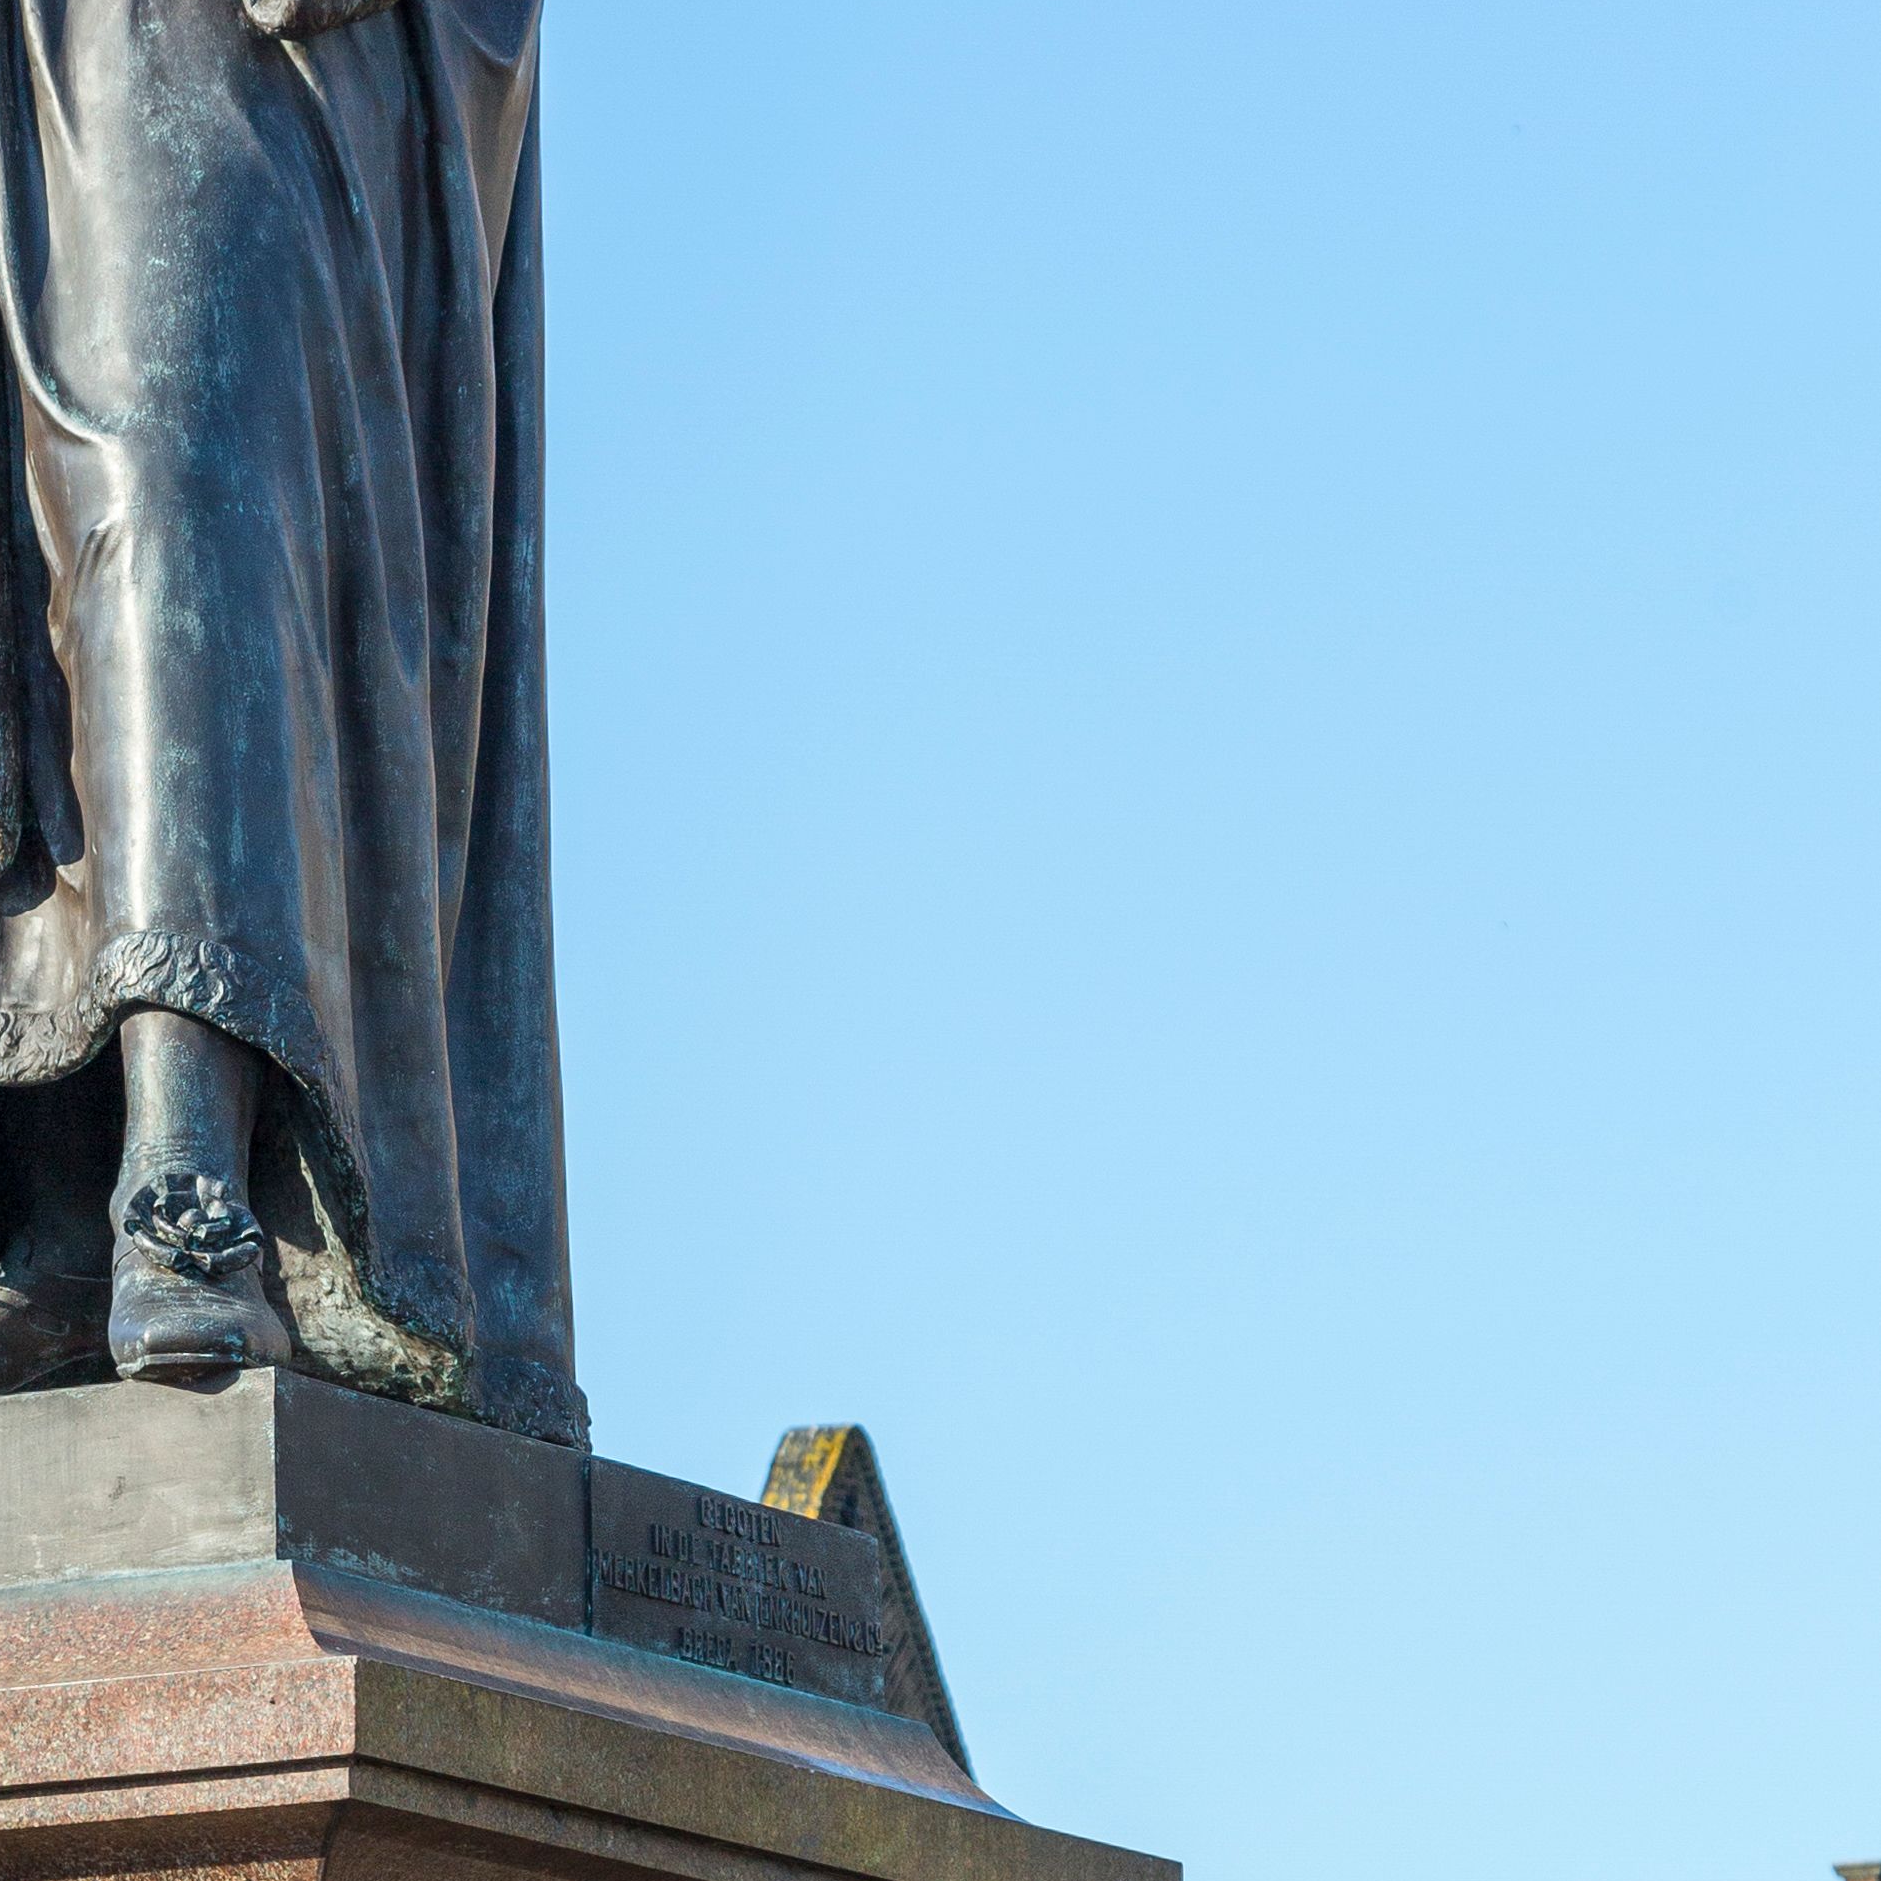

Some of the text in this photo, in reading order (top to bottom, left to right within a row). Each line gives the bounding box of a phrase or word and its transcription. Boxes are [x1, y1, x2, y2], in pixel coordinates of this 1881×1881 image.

[699, 1496, 782, 1546] GEGOTEN
[595, 1547, 717, 1612] MERKELBACH
[718, 1582, 751, 1623] VAN
[652, 1523, 827, 1600] IN DE FABRIEK VAN
[680, 1626, 796, 1686] BREDA 1886
